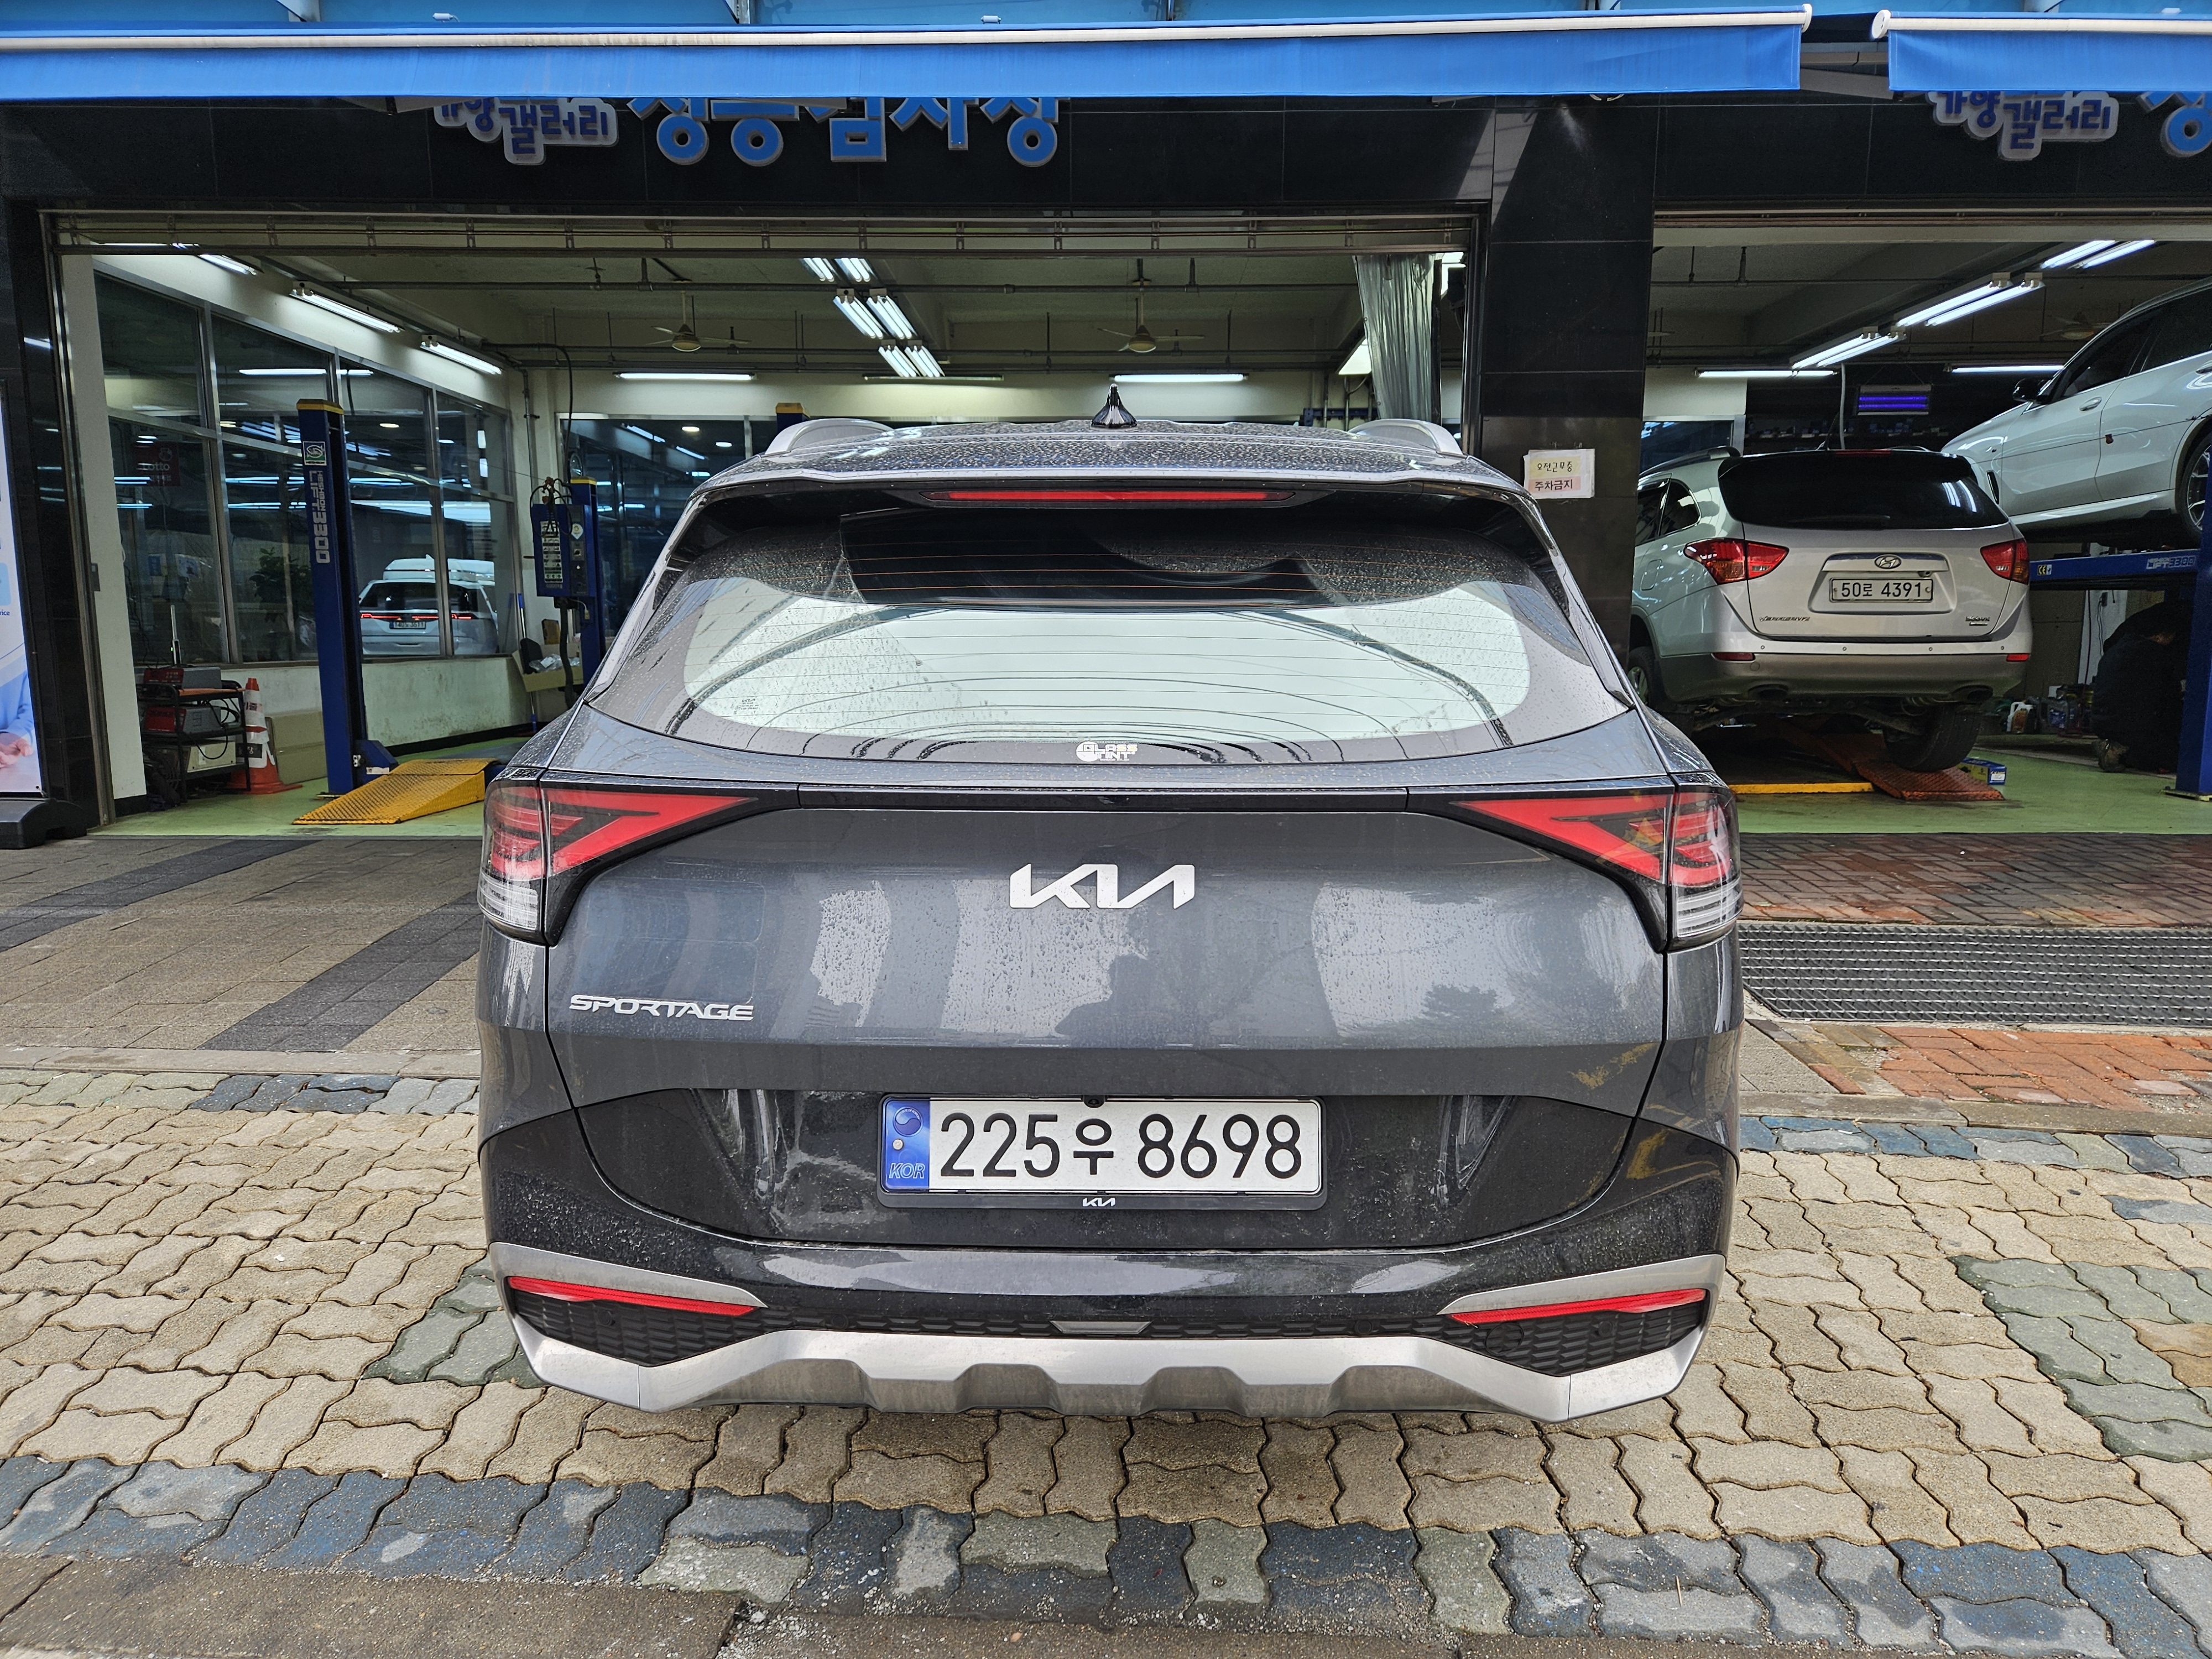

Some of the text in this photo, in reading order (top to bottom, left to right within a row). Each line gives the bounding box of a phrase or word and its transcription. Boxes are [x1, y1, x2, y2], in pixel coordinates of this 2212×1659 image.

[1535, 479, 1573, 492] 주차금지
[1841, 582, 1921, 597] 50로 4391
[1083, 744, 1138, 752] GLASS
[1009, 863, 1196, 909] KIA
[569, 994, 754, 1021] SPORTAGE
[940, 1112, 1302, 1178] 225우 8698
[888, 1162, 926, 1179] KOR
[1082, 1197, 1116, 1207] KIA
